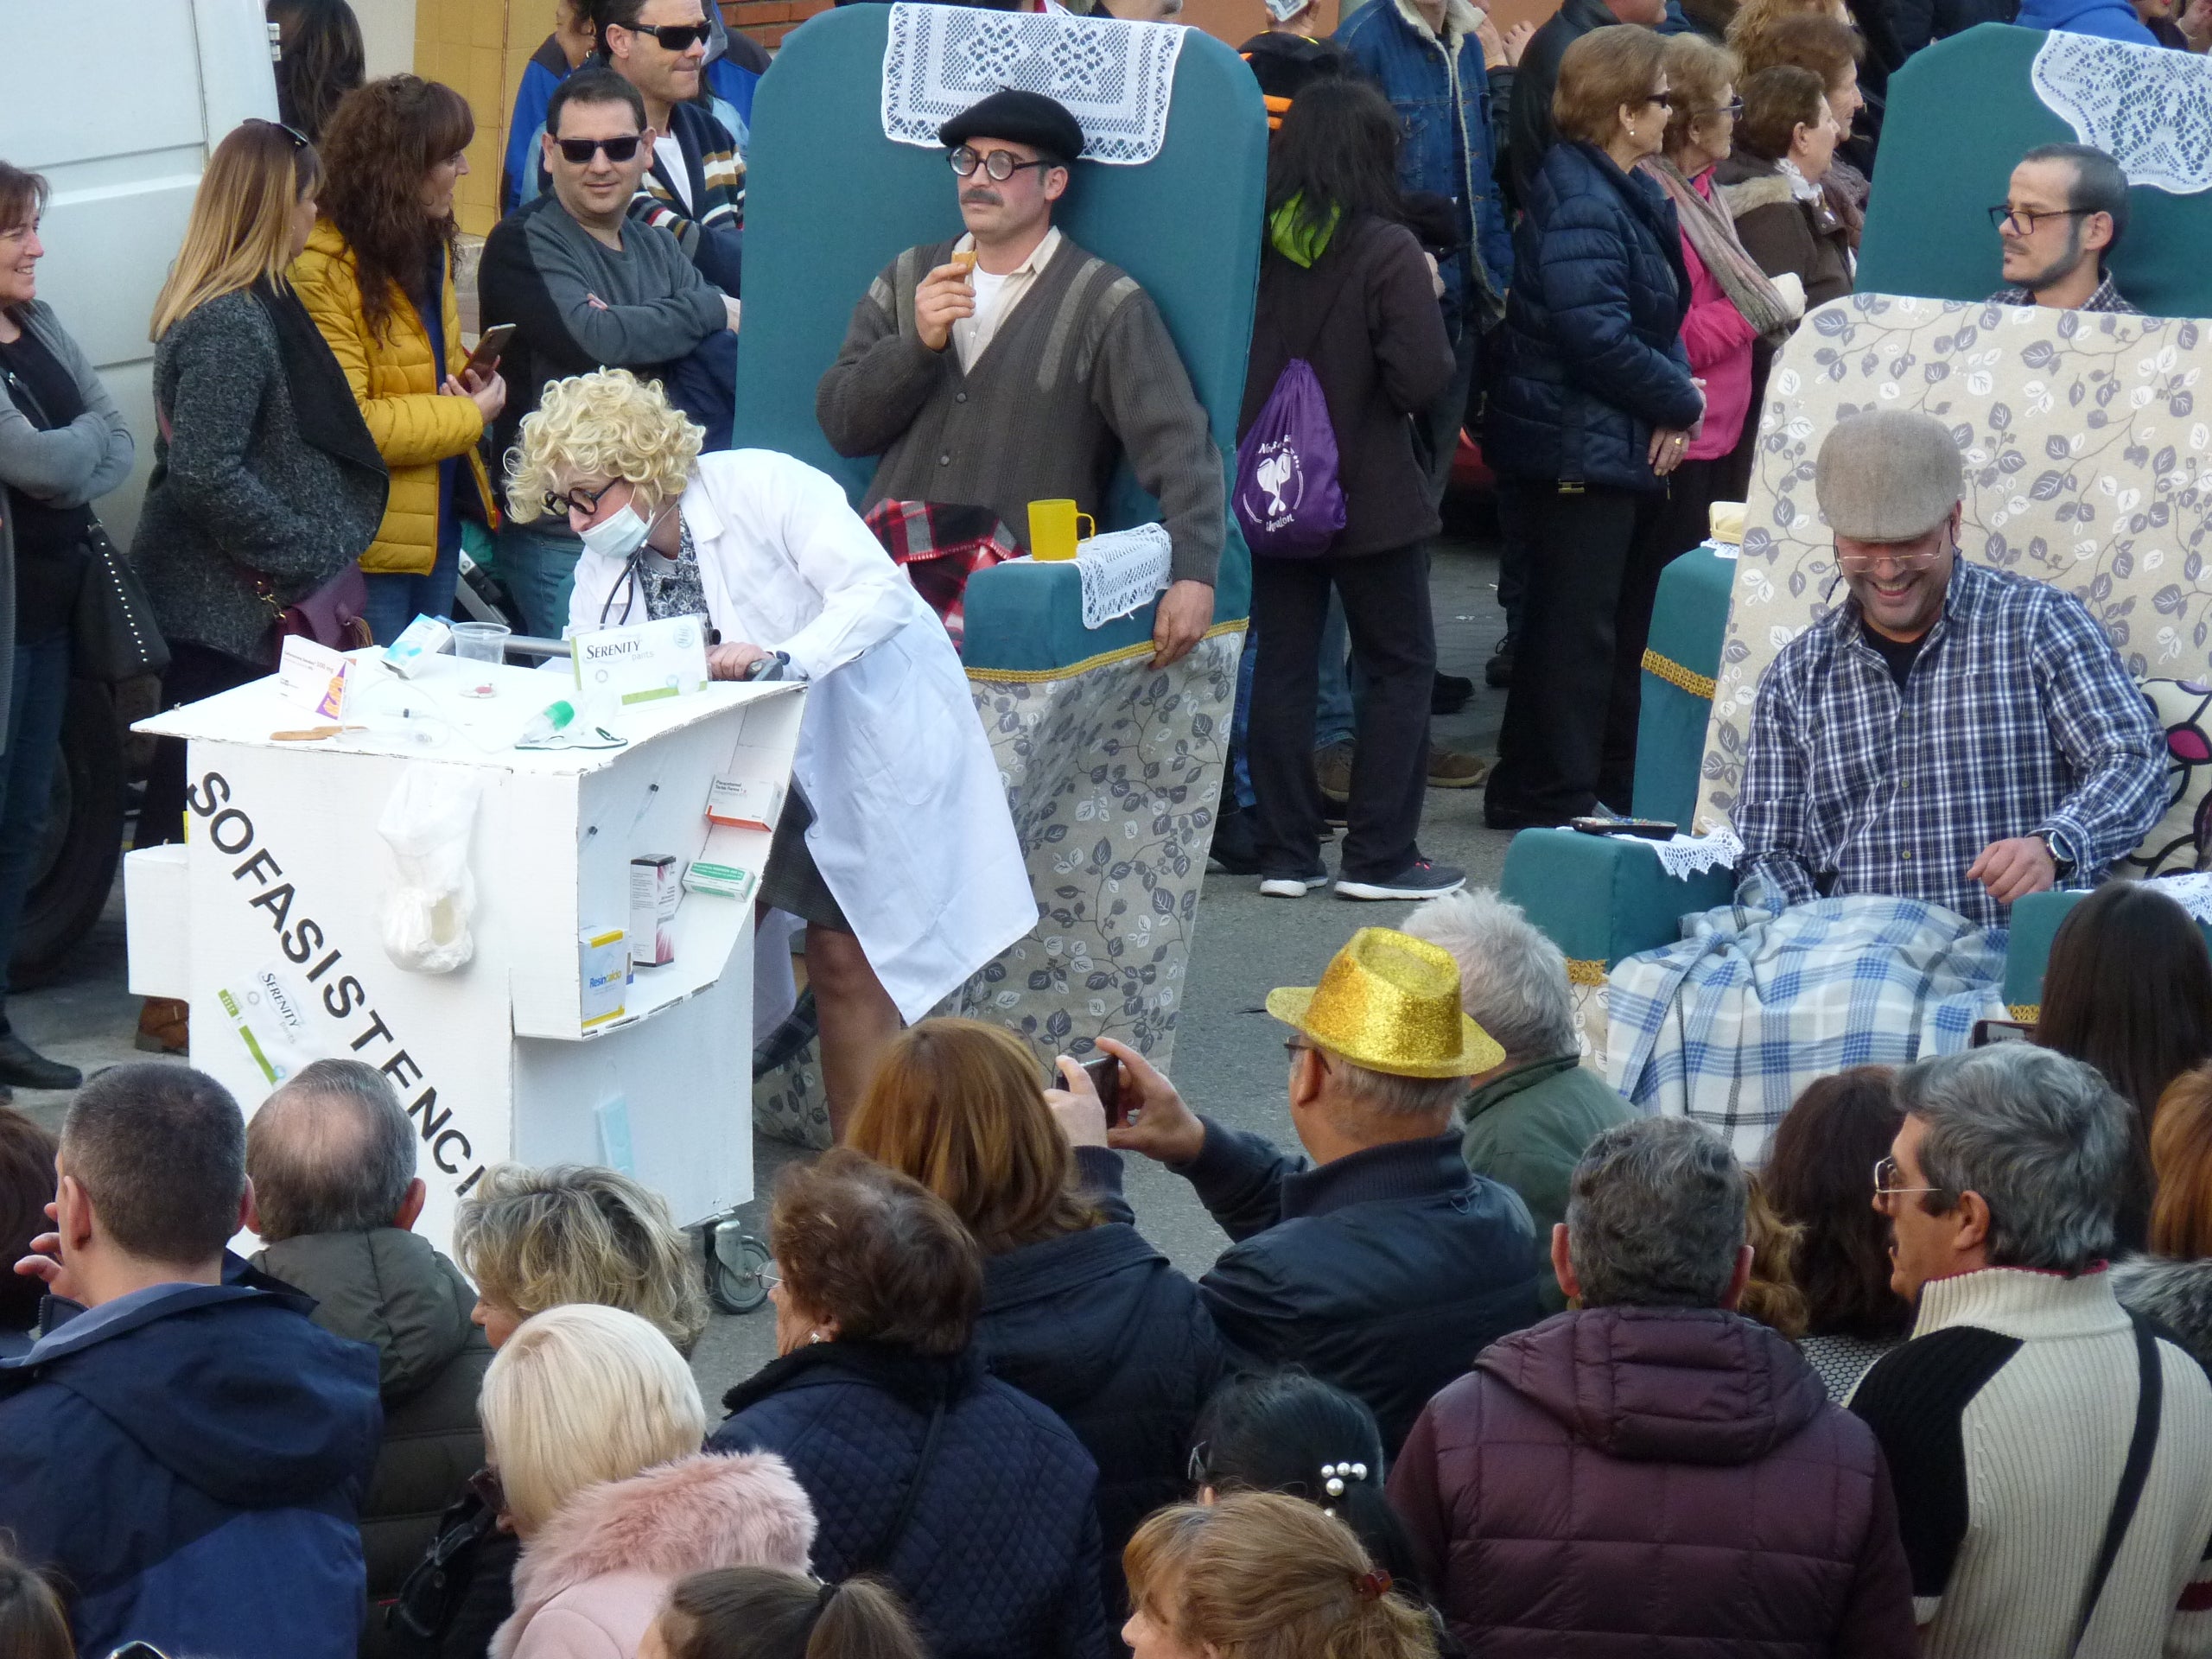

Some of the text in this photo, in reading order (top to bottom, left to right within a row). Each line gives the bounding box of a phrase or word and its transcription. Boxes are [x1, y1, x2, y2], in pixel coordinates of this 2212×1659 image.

[586, 640, 640, 659] SERENITY
[632, 652, 655, 662] pants
[188, 772, 486, 1197] SOFASISTENCI
[262, 973, 300, 1027] SERENITY
